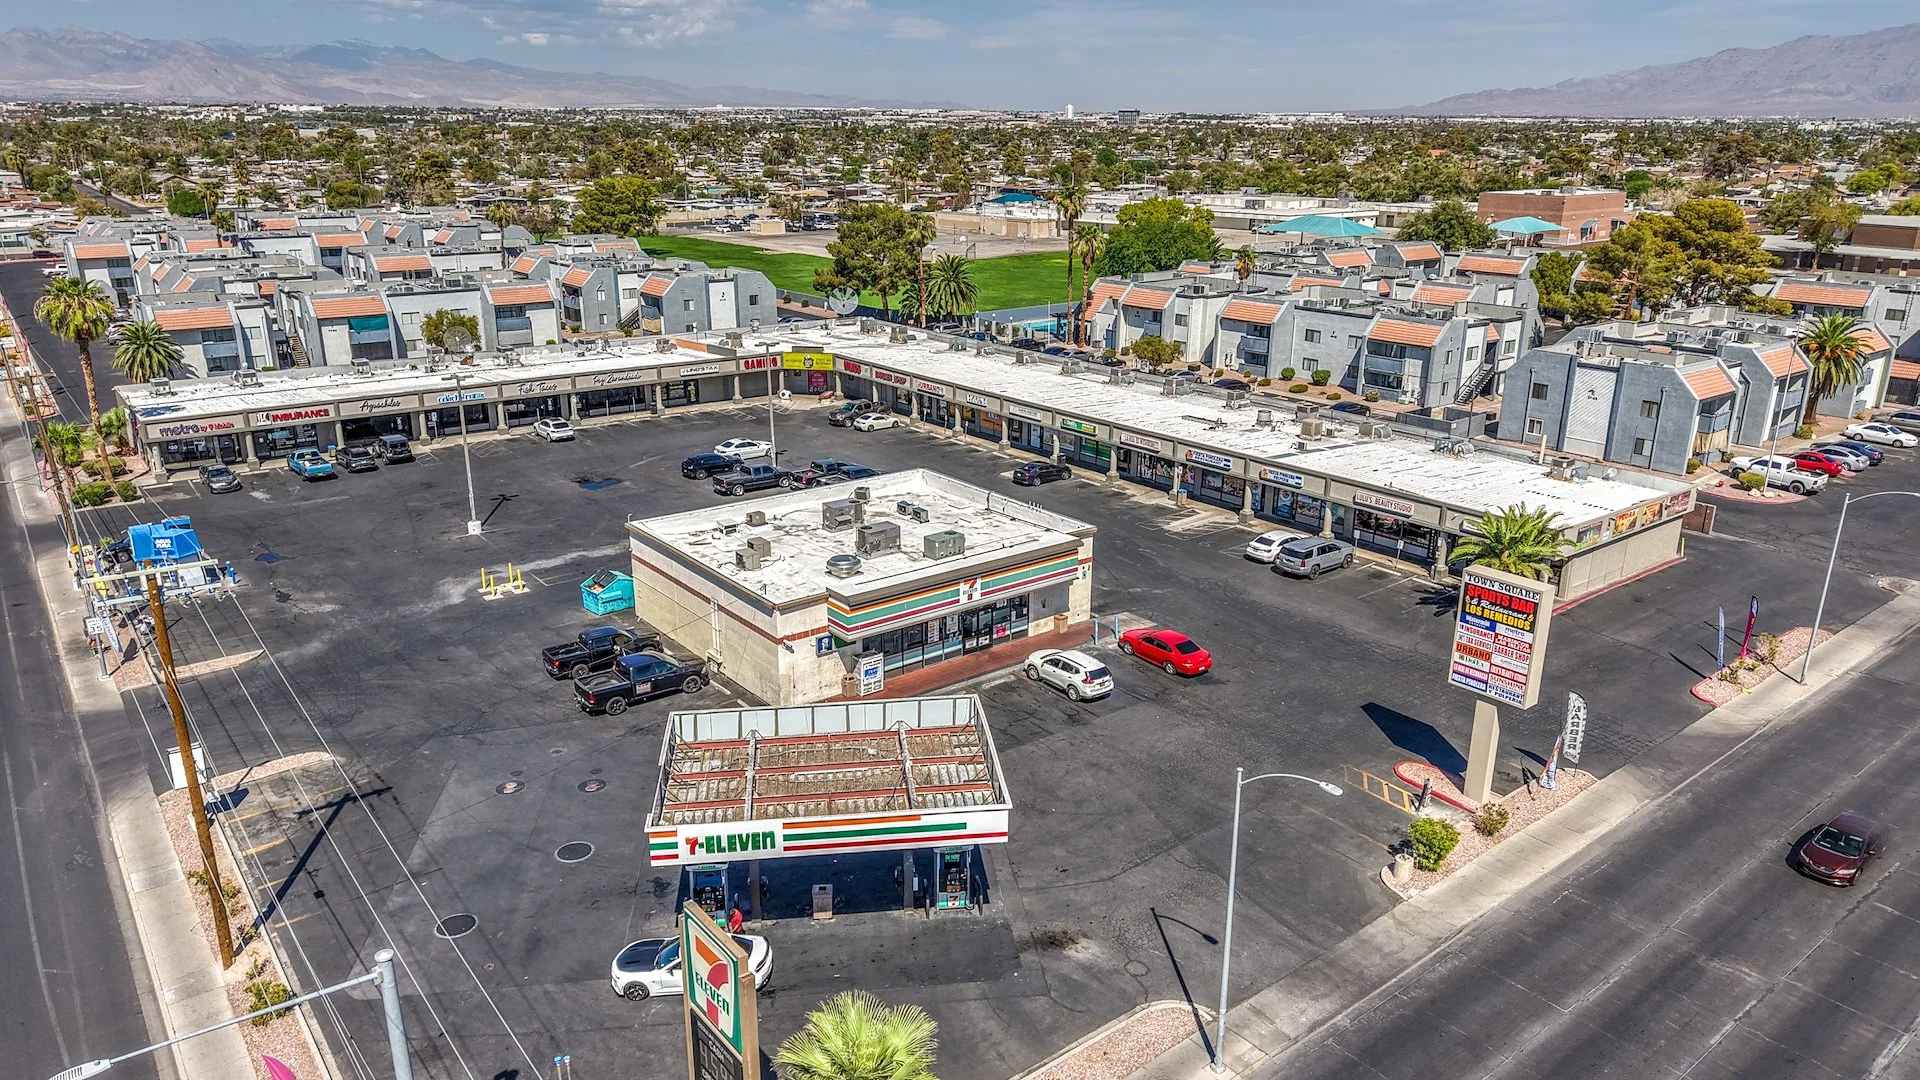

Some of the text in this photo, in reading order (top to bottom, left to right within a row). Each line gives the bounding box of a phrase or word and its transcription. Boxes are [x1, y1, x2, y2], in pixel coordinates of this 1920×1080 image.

[518, 382, 558, 395] Fish Tacos
[272, 409, 330, 422] INSURANCE
[159, 424, 199, 437] metro
[1356, 494, 1372, 503] LULU'S
[1375, 498, 1393, 509] BEAUTY
[1468, 574, 1538, 600] TOWN SQUARE
[1468, 585, 1534, 613] SPORTS BAR
[1465, 604, 1482, 616] LOS
[1483, 609, 1531, 630] REMEDIOS
[1480, 600, 1527, 619] Restaurant
[1464, 625, 1493, 639] INSURANCE
[1456, 643, 1490, 660] URBANO
[1474, 639, 1492, 650] SERVICE
[1494, 645, 1529, 663] BARBER SHOP
[1491, 675, 1524, 690] SUNSHINE
[1494, 691, 1522, 704] PULPERIA
